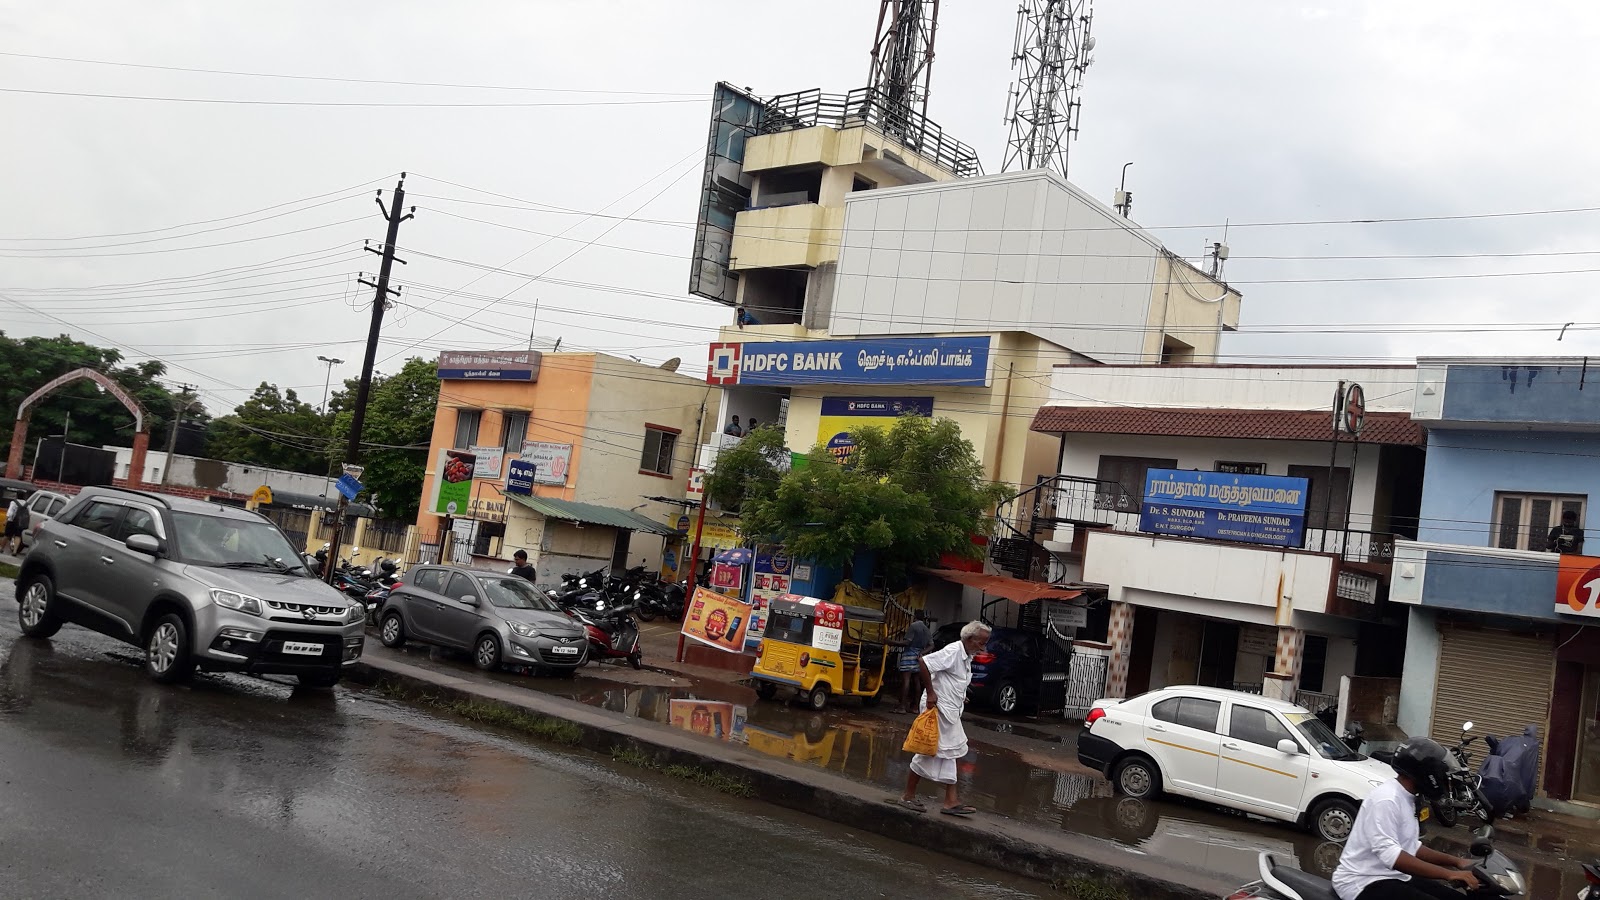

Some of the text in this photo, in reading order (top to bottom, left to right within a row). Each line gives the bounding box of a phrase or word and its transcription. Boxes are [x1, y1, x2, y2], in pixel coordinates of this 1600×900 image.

[743, 352, 843, 371] HDFC BANK
[940, 348, 973, 367] பாங்க்
[1149, 473, 1301, 507] ராம்தாஸ் மருத்துவமனை
[1149, 506, 1206, 519] Dr. S. SUNDAR
[1217, 511, 1291, 527] Dr. PRAVEENA SUNDAR
[1169, 524, 1196, 532] SURGEON
